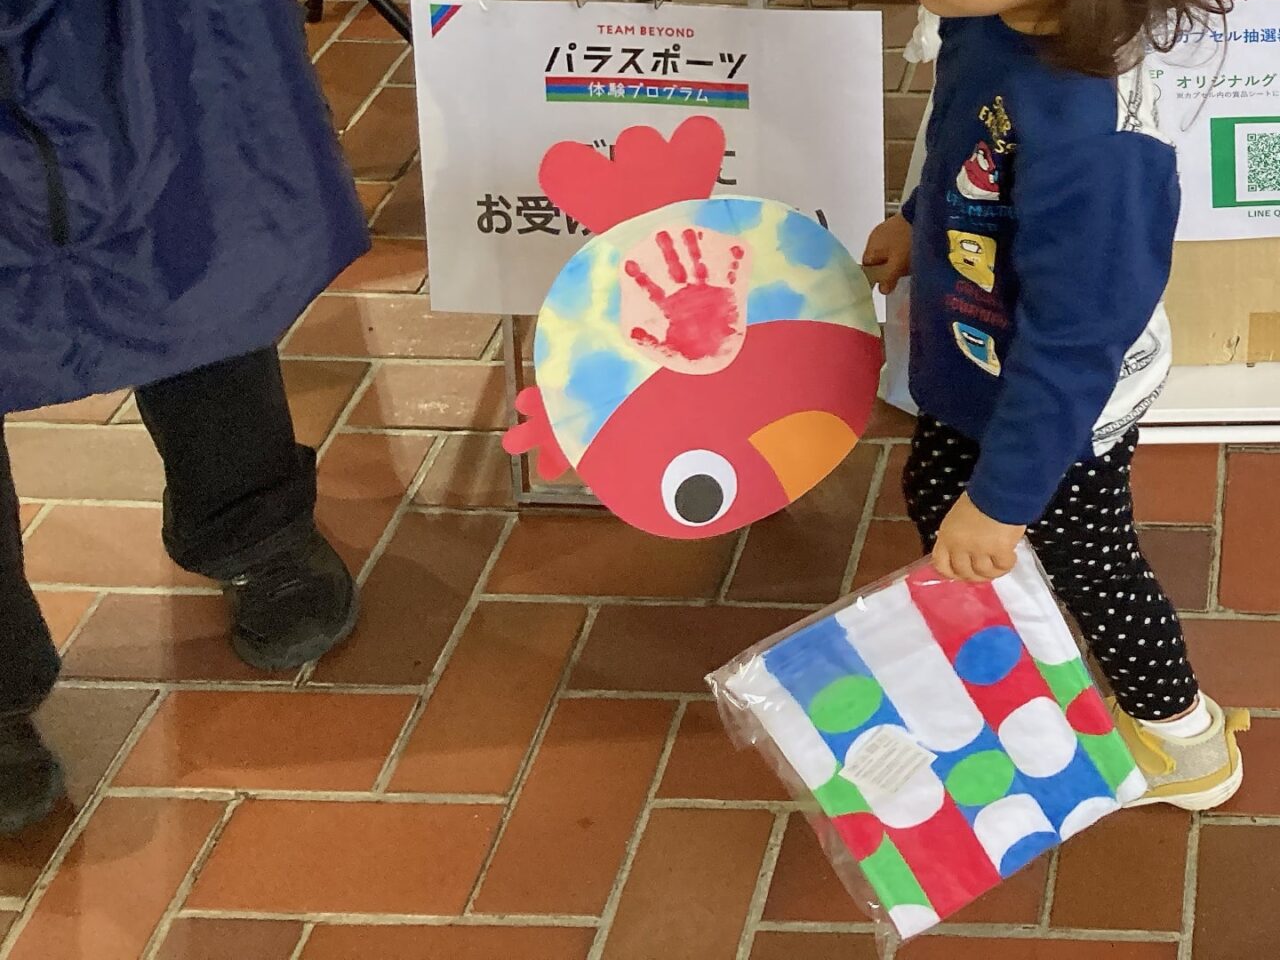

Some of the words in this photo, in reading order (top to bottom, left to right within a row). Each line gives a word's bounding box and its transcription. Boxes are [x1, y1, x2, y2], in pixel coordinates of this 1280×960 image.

[597, 24, 635, 36] TEAM
[640, 26, 694, 38] BEYOND
[545, 42, 747, 79] パラスポーツ
[588, 82, 709, 104] 体験プログラム
[1248, 209, 1271, 218] LINE
